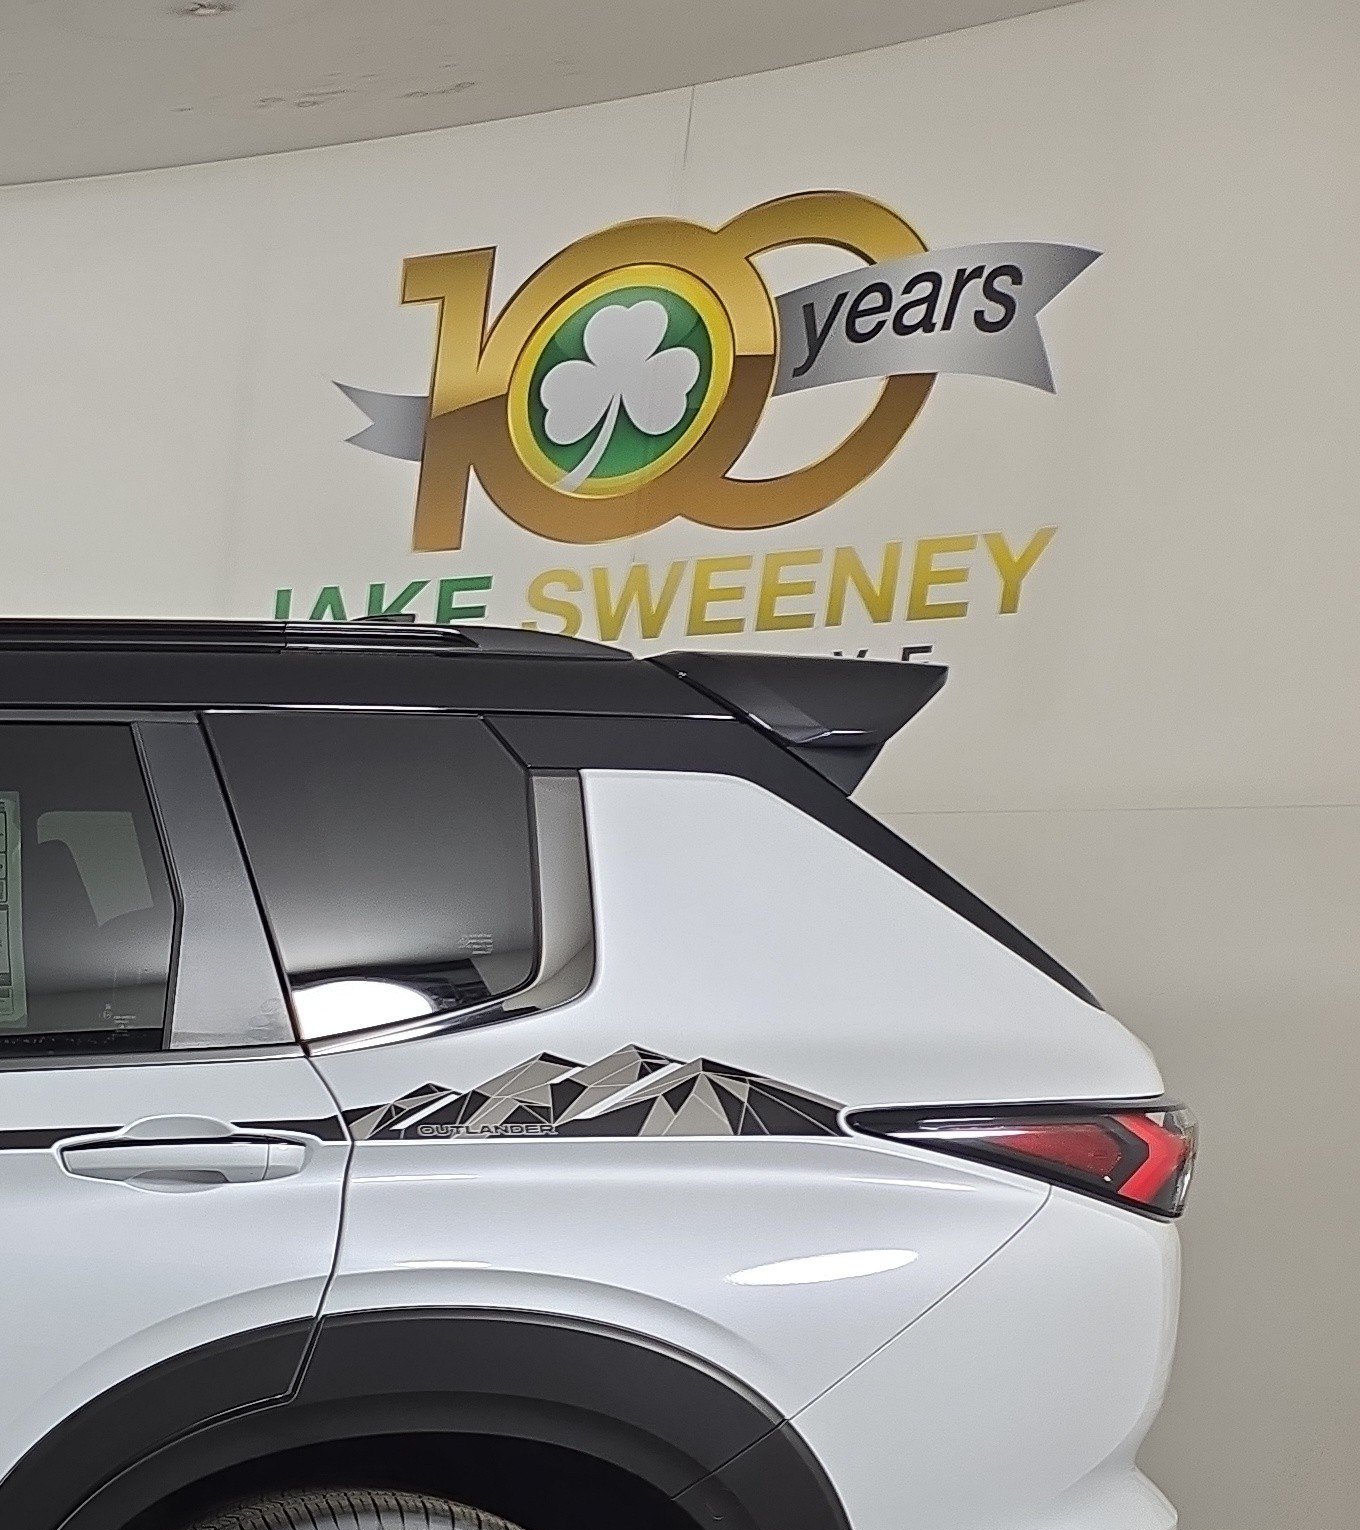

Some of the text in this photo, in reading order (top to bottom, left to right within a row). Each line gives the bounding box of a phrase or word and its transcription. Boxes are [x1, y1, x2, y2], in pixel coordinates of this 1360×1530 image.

[402, 190, 937, 552] 100
[793, 263, 1025, 377] years
[522, 526, 1059, 640] SWEENEY
[418, 1122, 558, 1136] OUTLANDER
